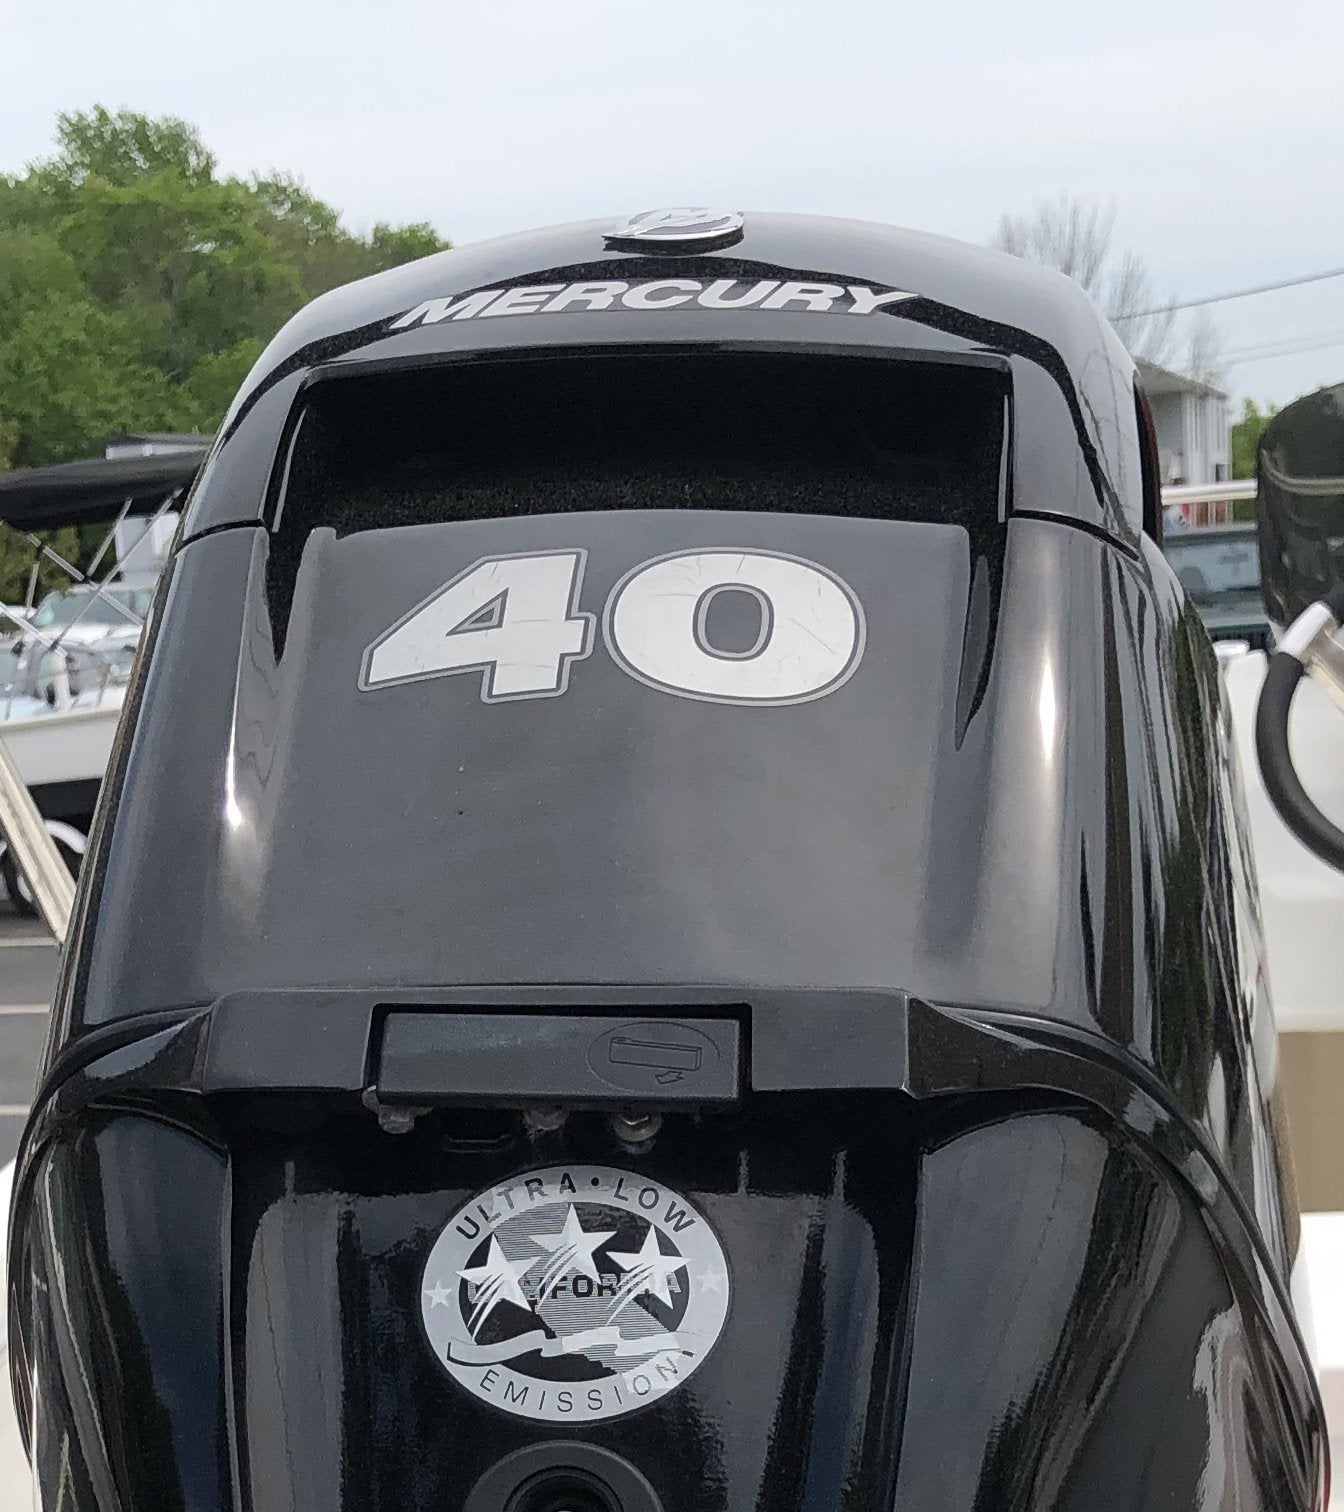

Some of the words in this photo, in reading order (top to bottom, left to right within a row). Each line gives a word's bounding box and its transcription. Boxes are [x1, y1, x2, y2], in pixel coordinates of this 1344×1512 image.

[389, 278, 920, 331] MERCURY
[360, 549, 865, 705] 40
[456, 1172, 576, 1240] ULTRA
[613, 1177, 695, 1234] LOW
